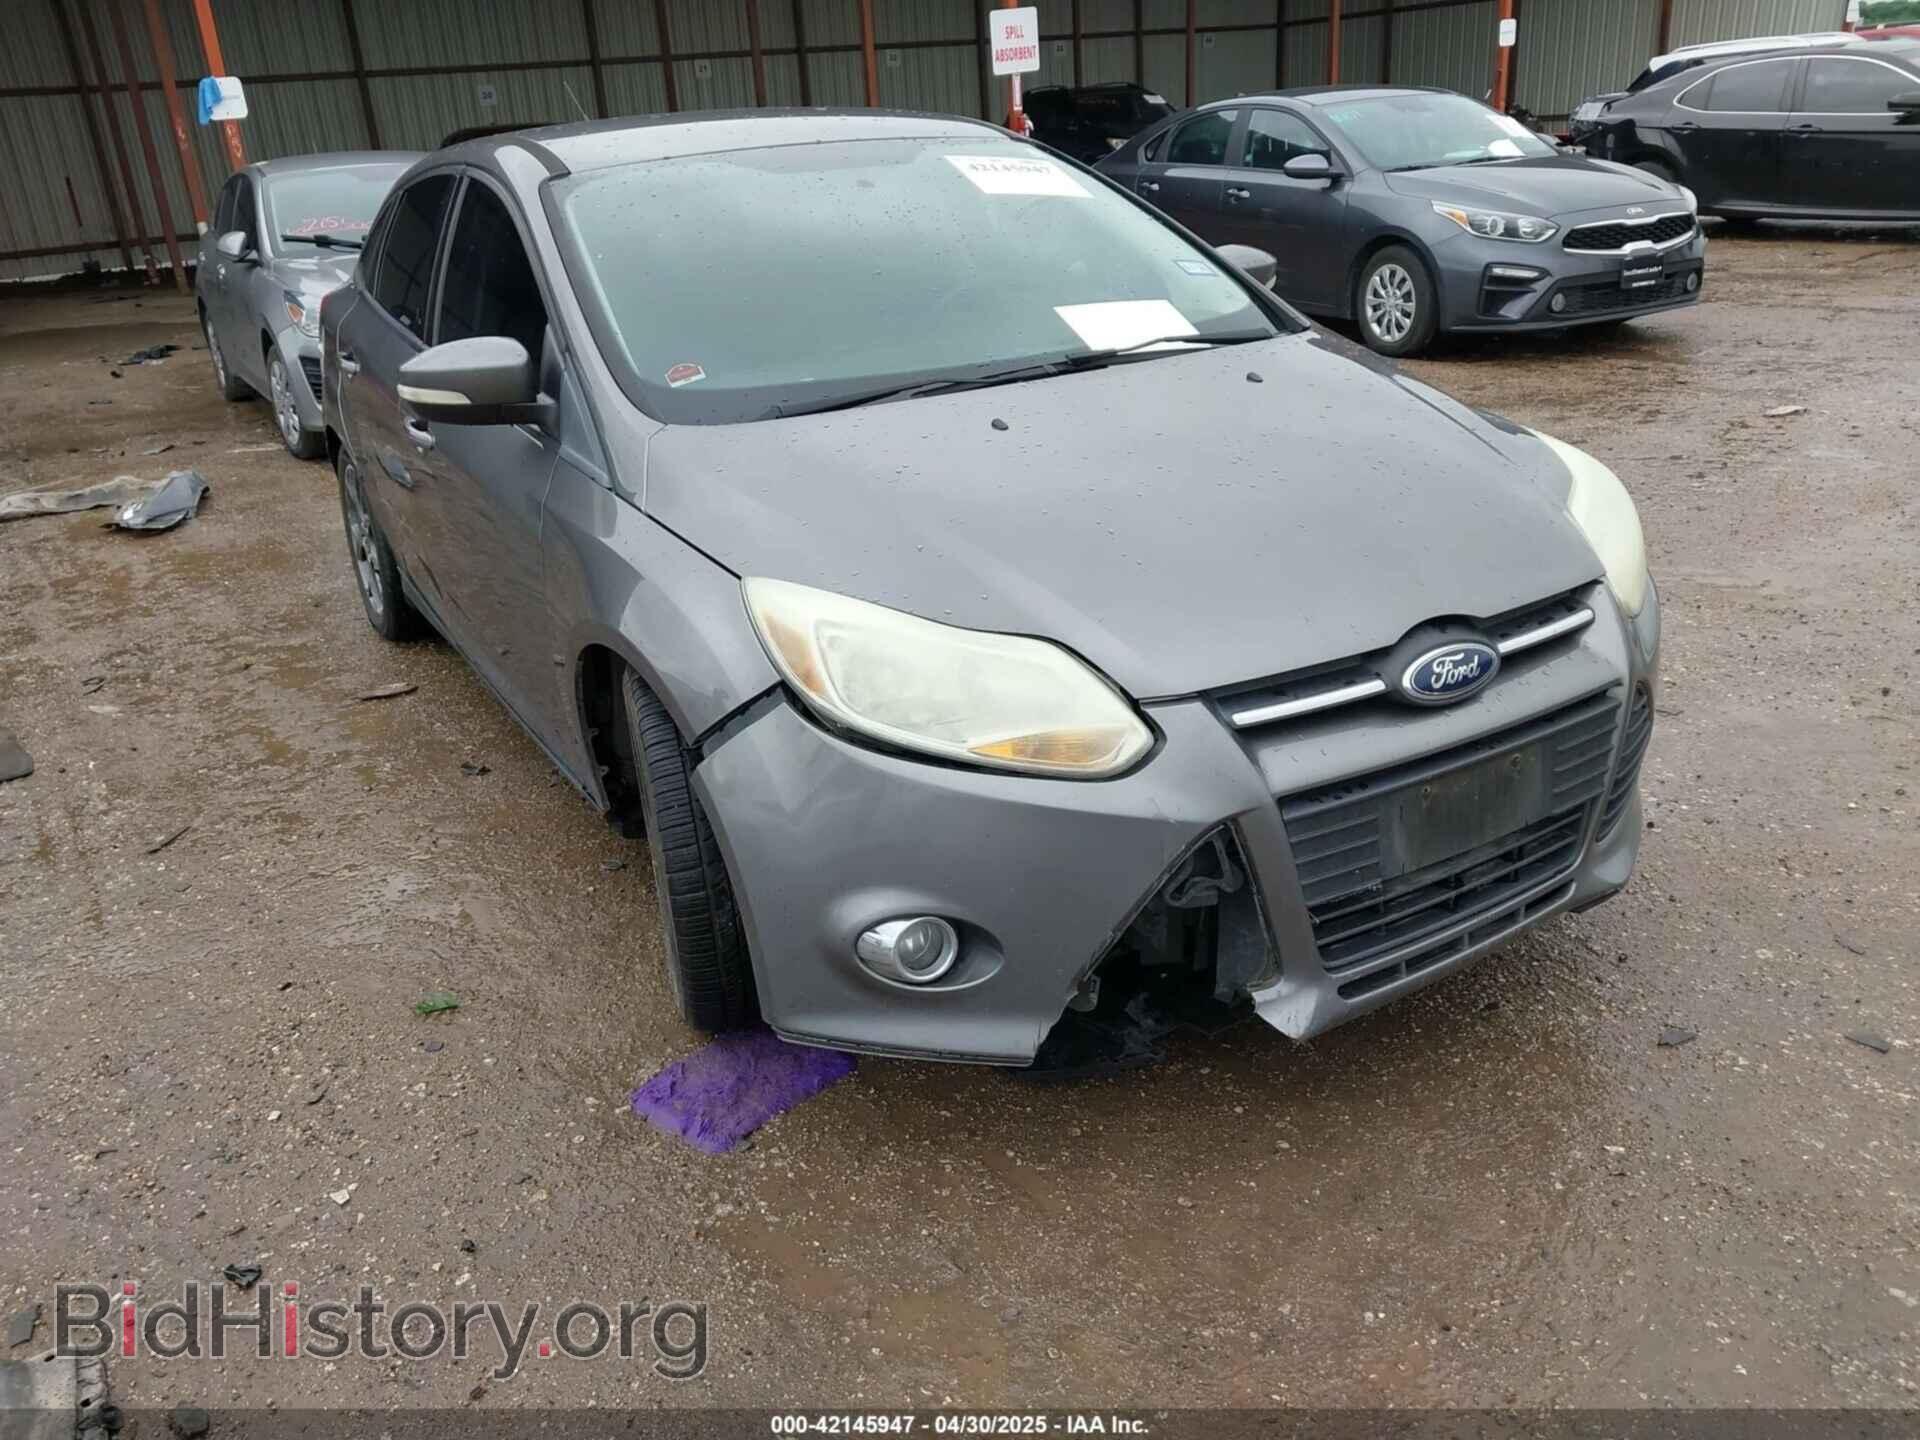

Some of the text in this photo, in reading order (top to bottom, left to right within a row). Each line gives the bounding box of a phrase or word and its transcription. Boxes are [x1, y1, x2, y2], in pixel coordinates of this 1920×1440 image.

[1005, 25, 1025, 40] SPILL
[995, 44, 1037, 62] ABSORBENT
[1431, 652, 1481, 689] Ford
